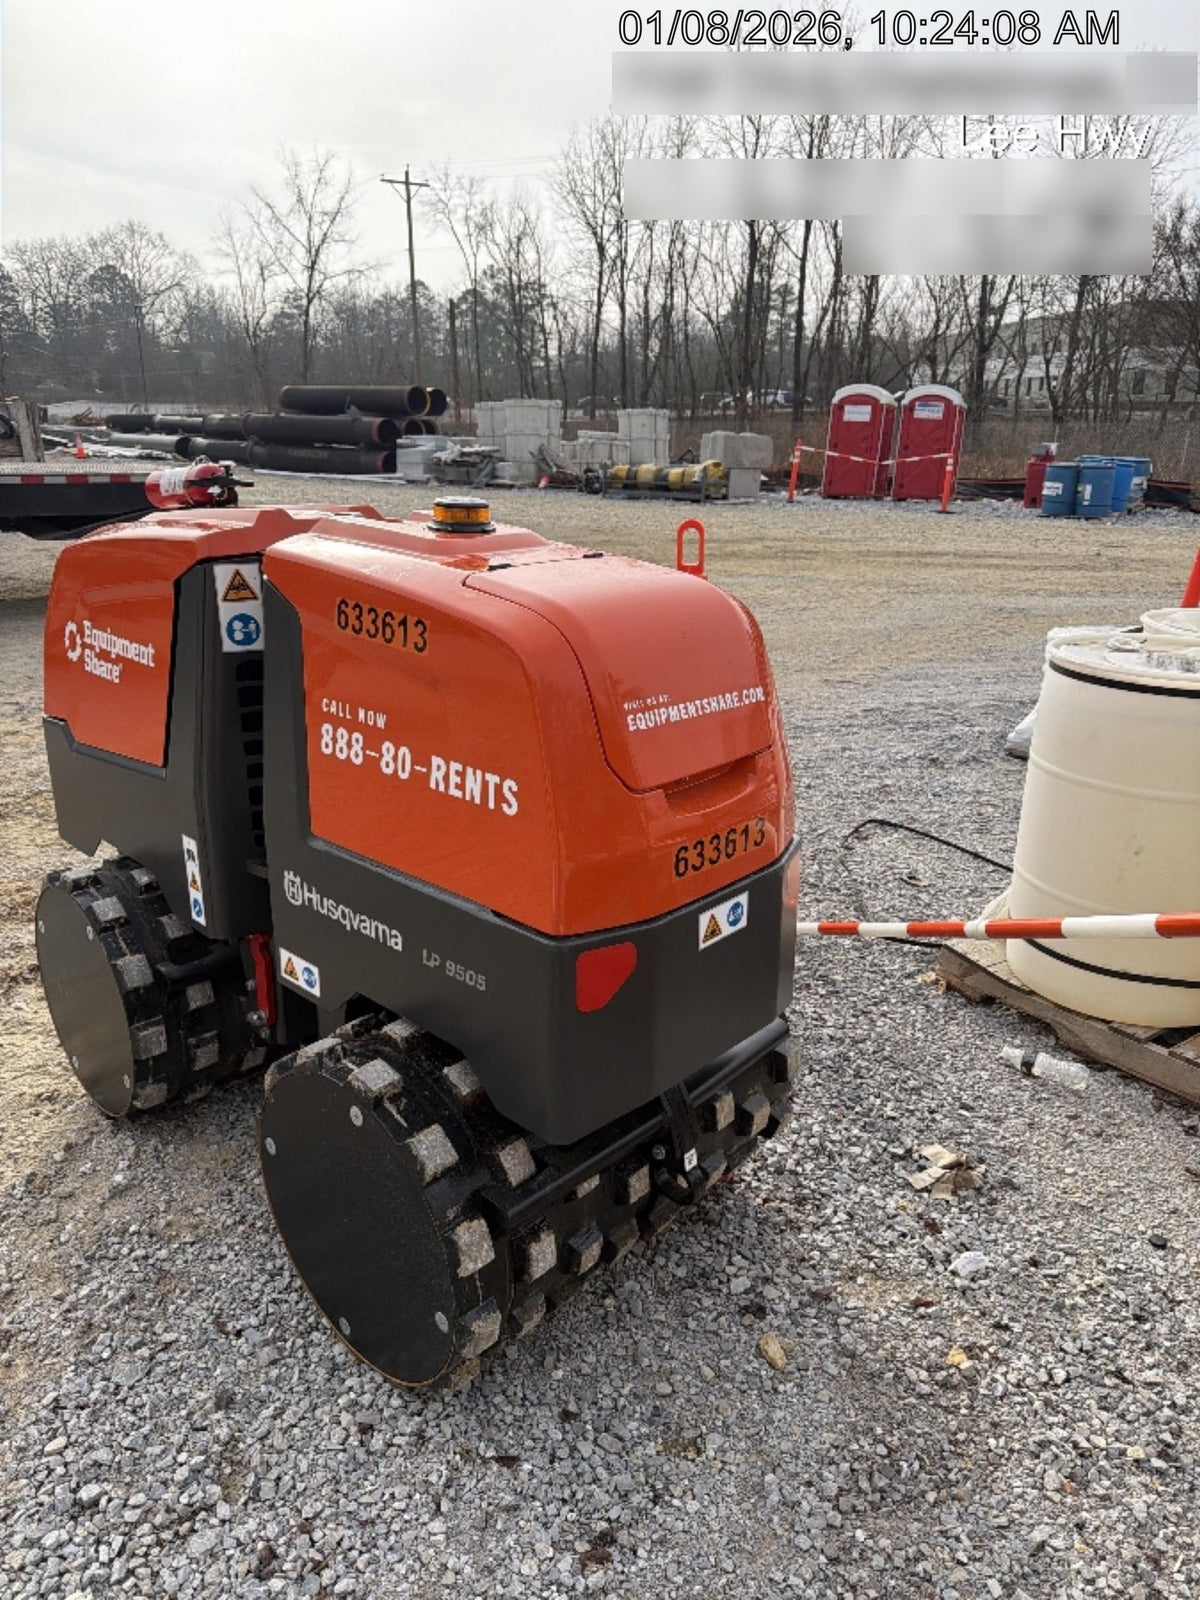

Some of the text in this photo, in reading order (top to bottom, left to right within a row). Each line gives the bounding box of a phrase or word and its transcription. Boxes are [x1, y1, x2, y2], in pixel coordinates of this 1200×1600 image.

[83, 620, 155, 667] Equipment
[336, 598, 428, 654] 633613
[84, 649, 121, 683] Share
[321, 698, 387, 730] CALL NOW
[627, 686, 766, 731] EQUIPMENTSHARE.COM
[320, 723, 519, 816] 888-80-RENTS
[674, 817, 766, 877] 633613
[303, 882, 403, 952] Husqvarna
[421, 949, 487, 991] LP 9505
